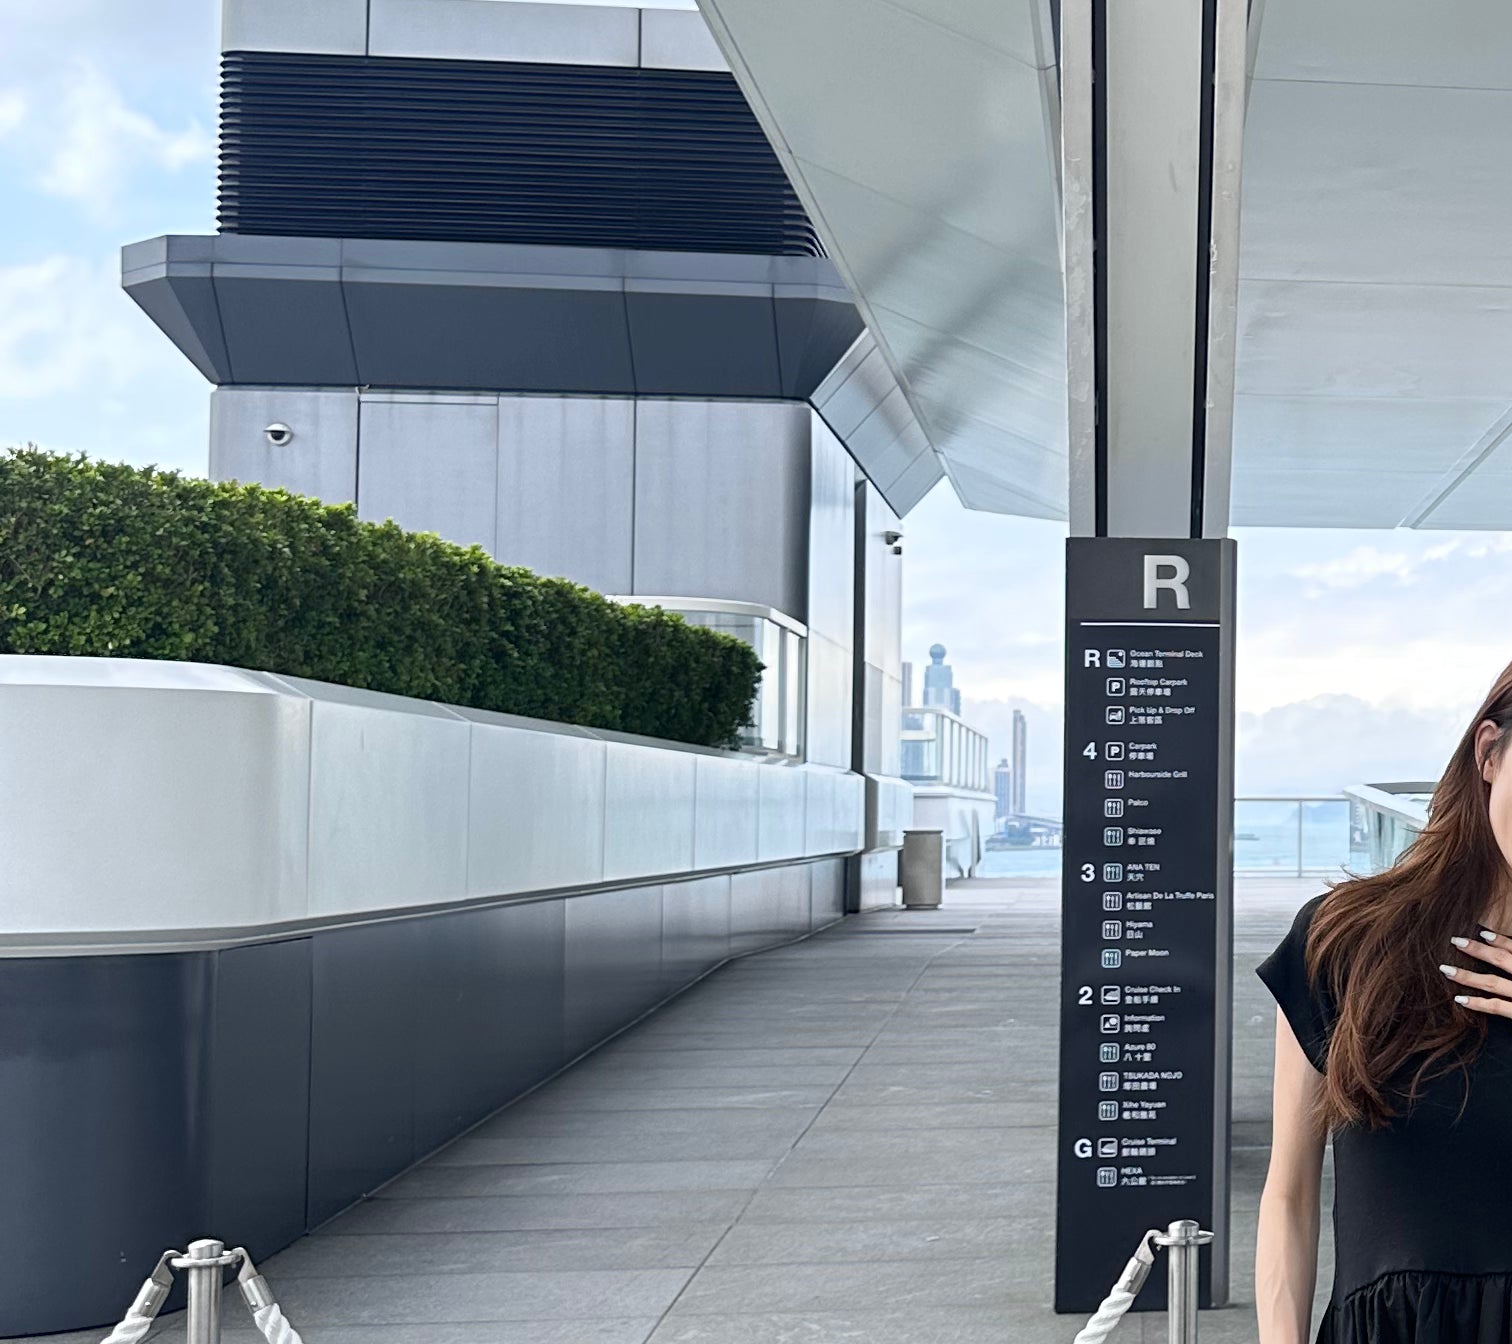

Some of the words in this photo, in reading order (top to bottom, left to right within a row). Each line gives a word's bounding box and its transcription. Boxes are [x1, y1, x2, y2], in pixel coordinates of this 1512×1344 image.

[1143, 554, 1191, 609] R
[1084, 649, 1100, 668] R
[1083, 742, 1097, 760] 4
[1081, 863, 1095, 882] 3
[1078, 986, 1093, 1005] 2
[1074, 1138, 1092, 1158] G
